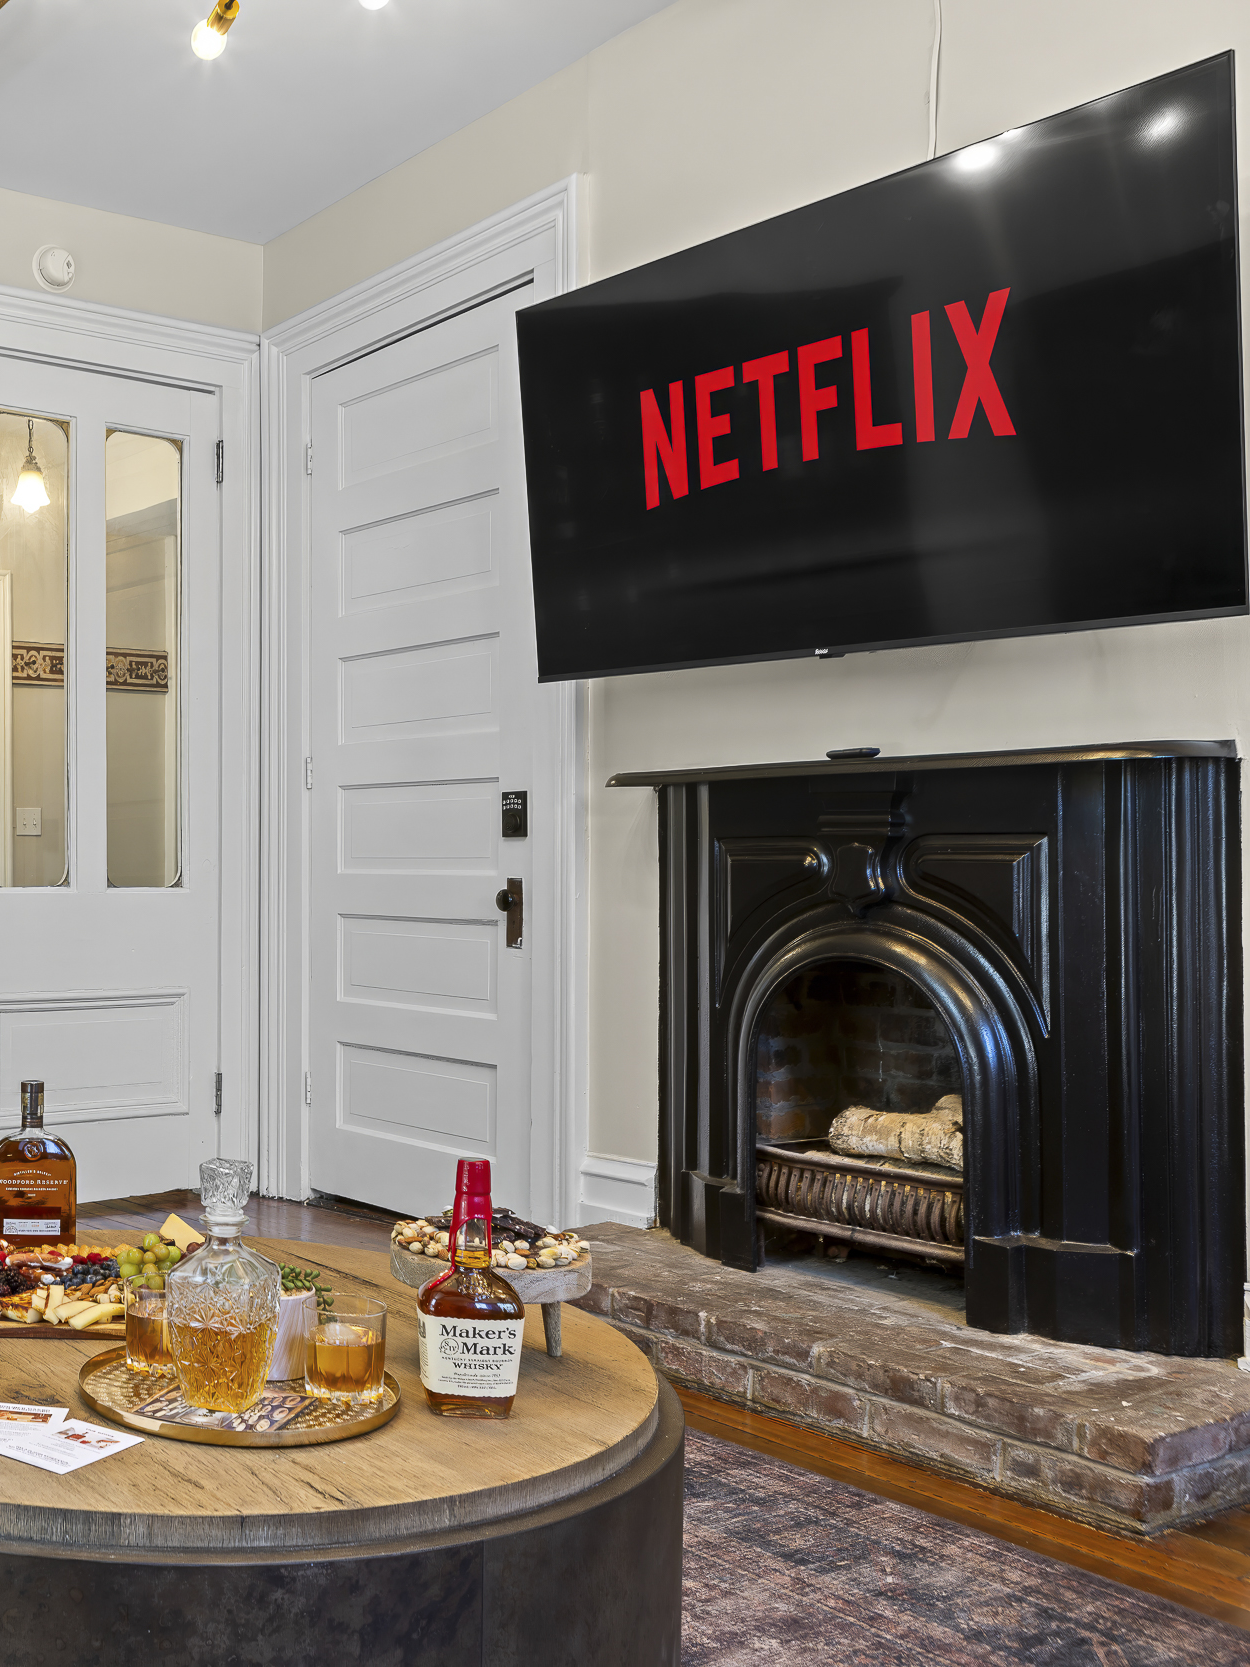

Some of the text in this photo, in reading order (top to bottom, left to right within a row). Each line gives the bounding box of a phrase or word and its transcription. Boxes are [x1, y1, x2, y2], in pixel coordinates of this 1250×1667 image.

[640, 287, 1017, 511] NETFLIX
[439, 1323, 517, 1340] Maker's
[459, 1342, 515, 1356] Mark
[452, 1362, 503, 1370] WHISKY
